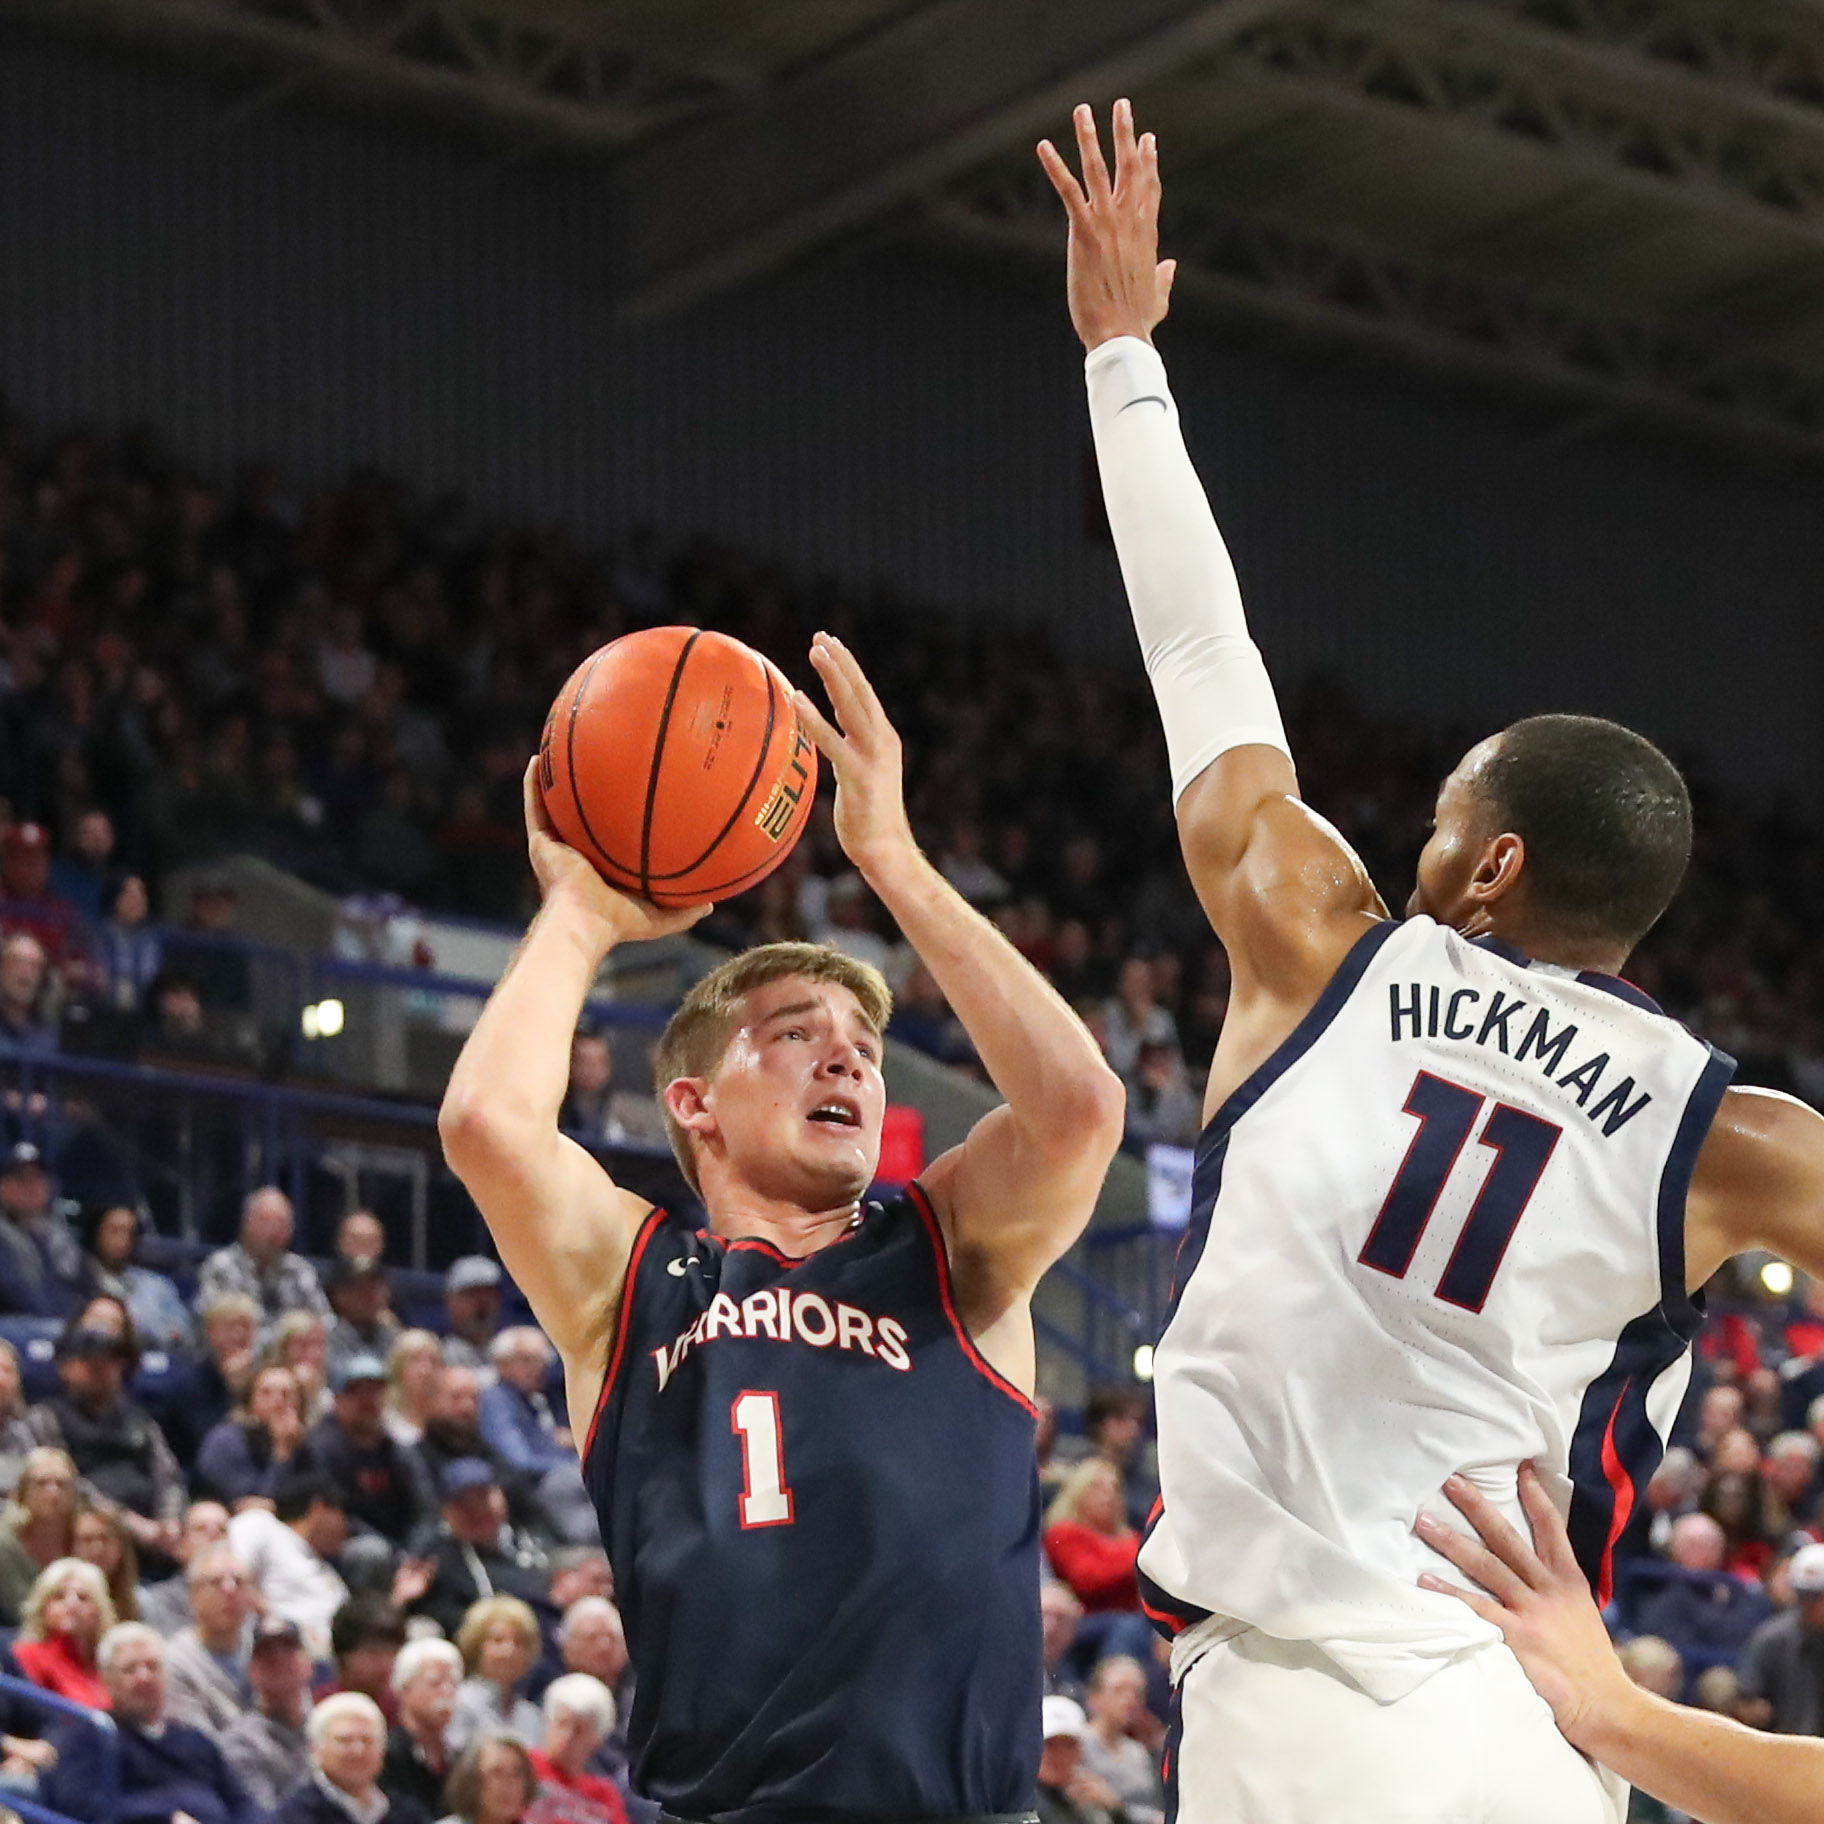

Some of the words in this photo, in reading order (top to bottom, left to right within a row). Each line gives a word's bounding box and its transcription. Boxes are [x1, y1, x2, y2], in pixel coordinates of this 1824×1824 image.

[1389, 983, 1652, 1138] HICKMAN
[1357, 1069, 1563, 1315] 11
[731, 1388, 795, 1530] 1
